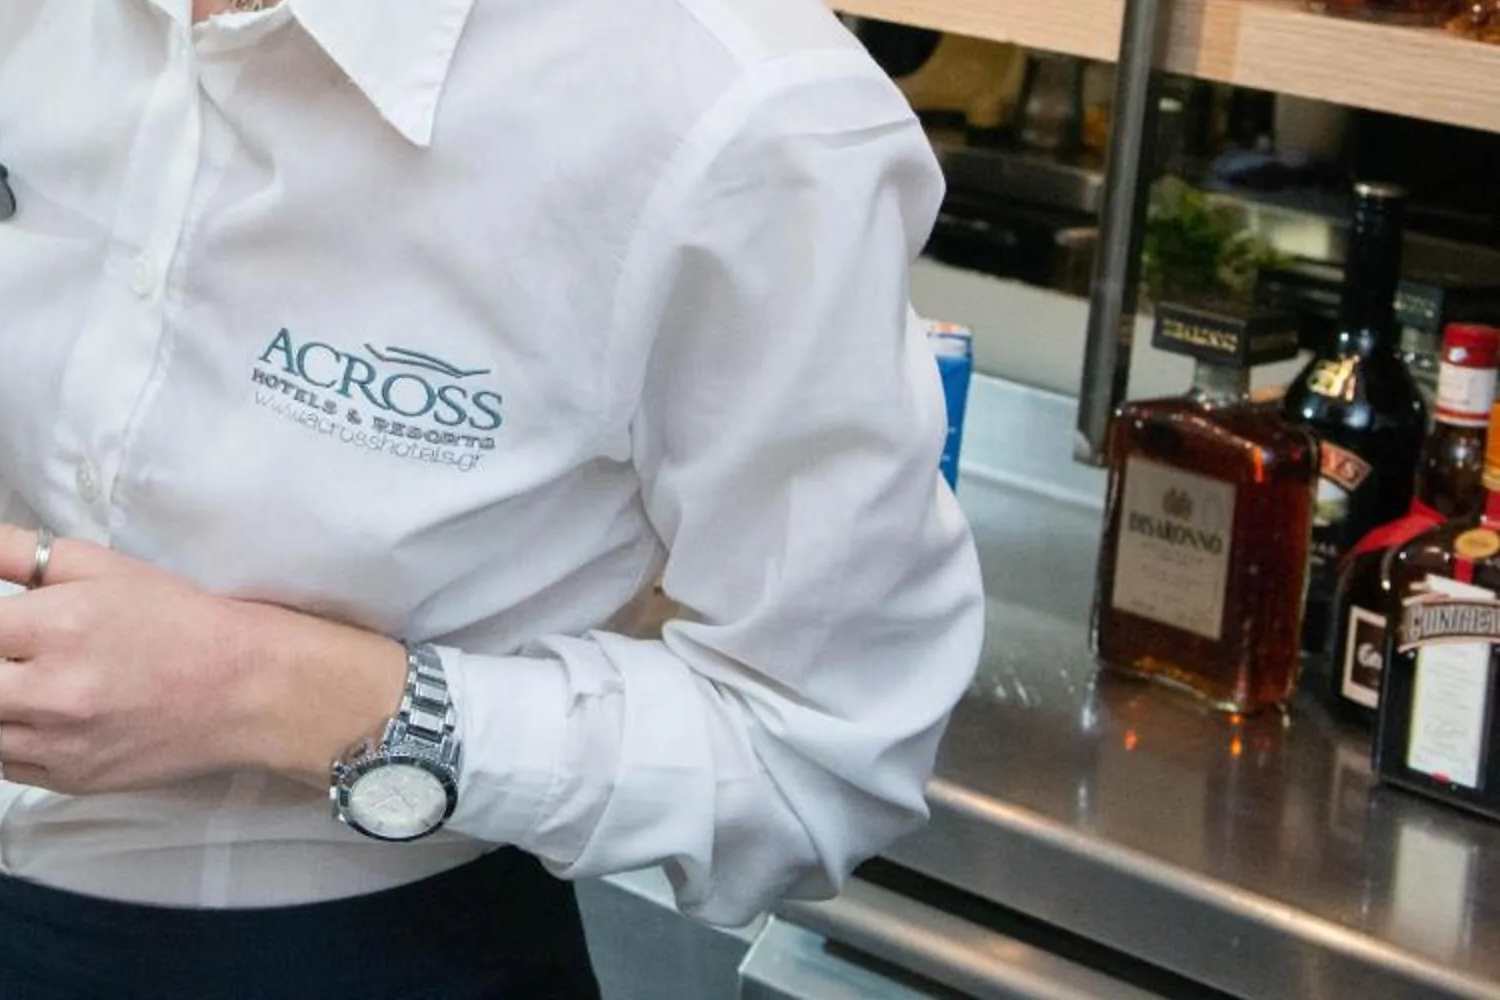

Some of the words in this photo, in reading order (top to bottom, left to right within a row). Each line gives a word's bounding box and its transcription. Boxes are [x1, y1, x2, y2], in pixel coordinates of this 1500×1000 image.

[251, 367, 338, 415] HOTELS
[345, 408, 363, 426] &
[372, 416, 497, 450] RESORTS
[258, 326, 504, 431] ACROSS
[1128, 510, 1223, 557] DISARONNO
